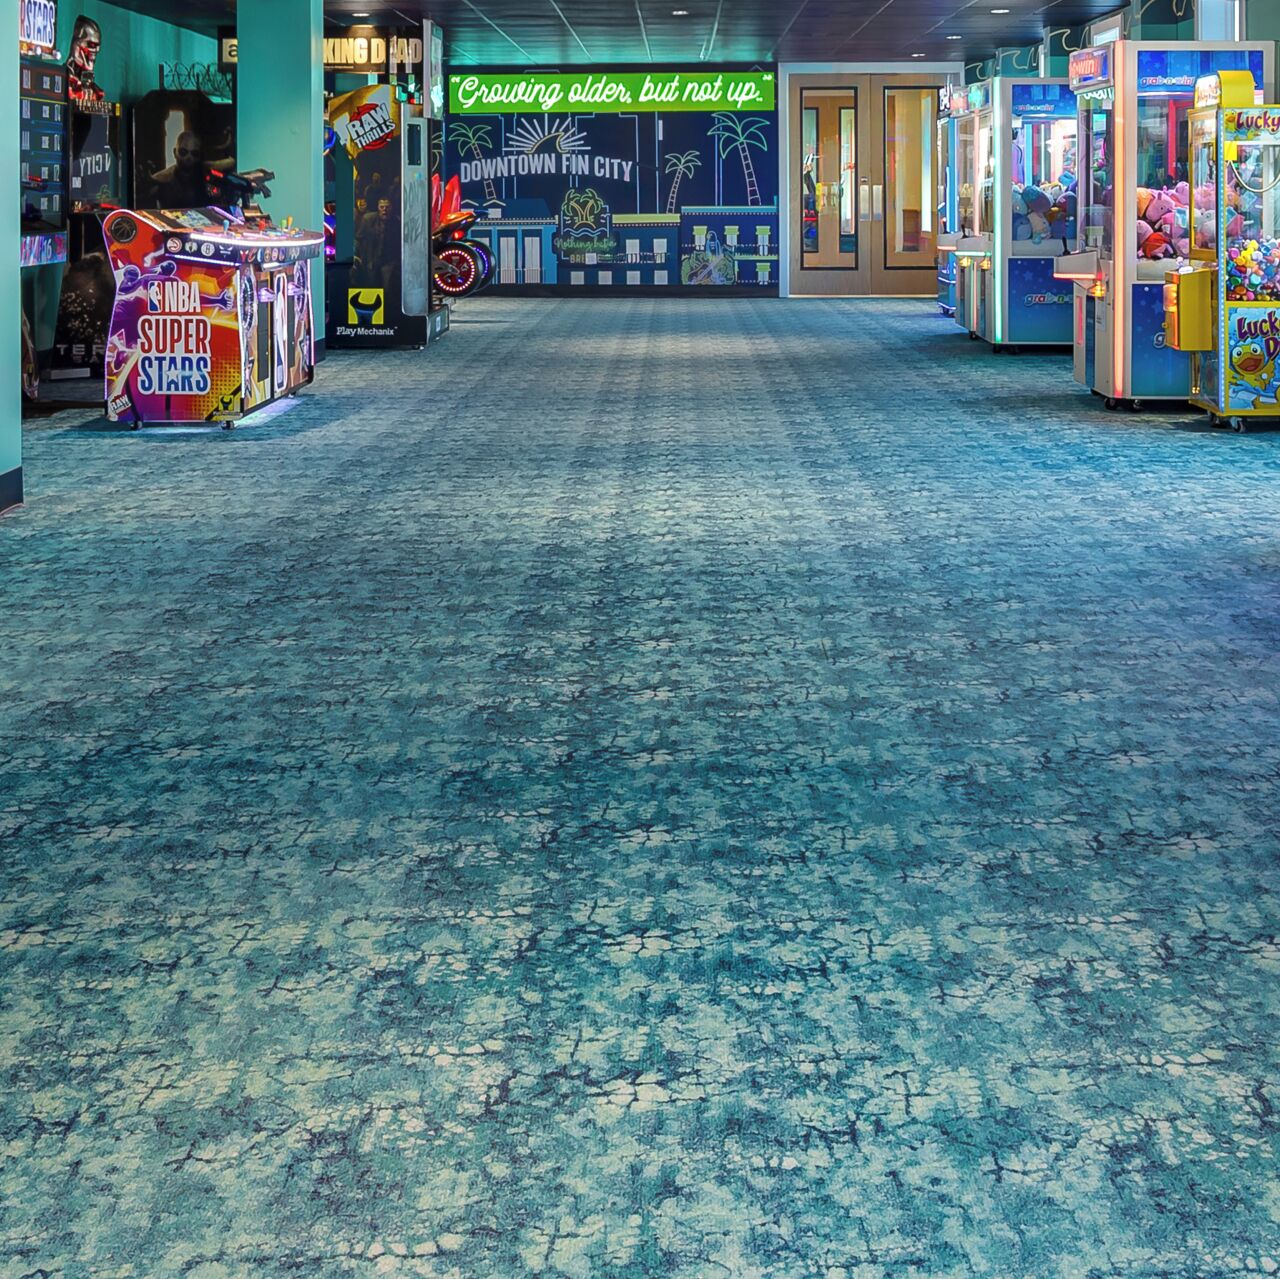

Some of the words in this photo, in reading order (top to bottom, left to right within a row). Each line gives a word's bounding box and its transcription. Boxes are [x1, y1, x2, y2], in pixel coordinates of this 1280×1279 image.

[638, 74, 680, 104] but
[682, 74, 724, 103] not
[346, 102, 390, 141] RAW
[354, 118, 396, 148] THRILLS
[460, 153, 556, 183] DOWNTOWN
[562, 153, 589, 175] FIN
[594, 155, 633, 182] CITY
[164, 281, 201, 313] NBA
[139, 318, 209, 355] SUPER
[336, 327, 357, 337] Play
[357, 327, 395, 336] Mechanix
[139, 355, 209, 392] STARS
